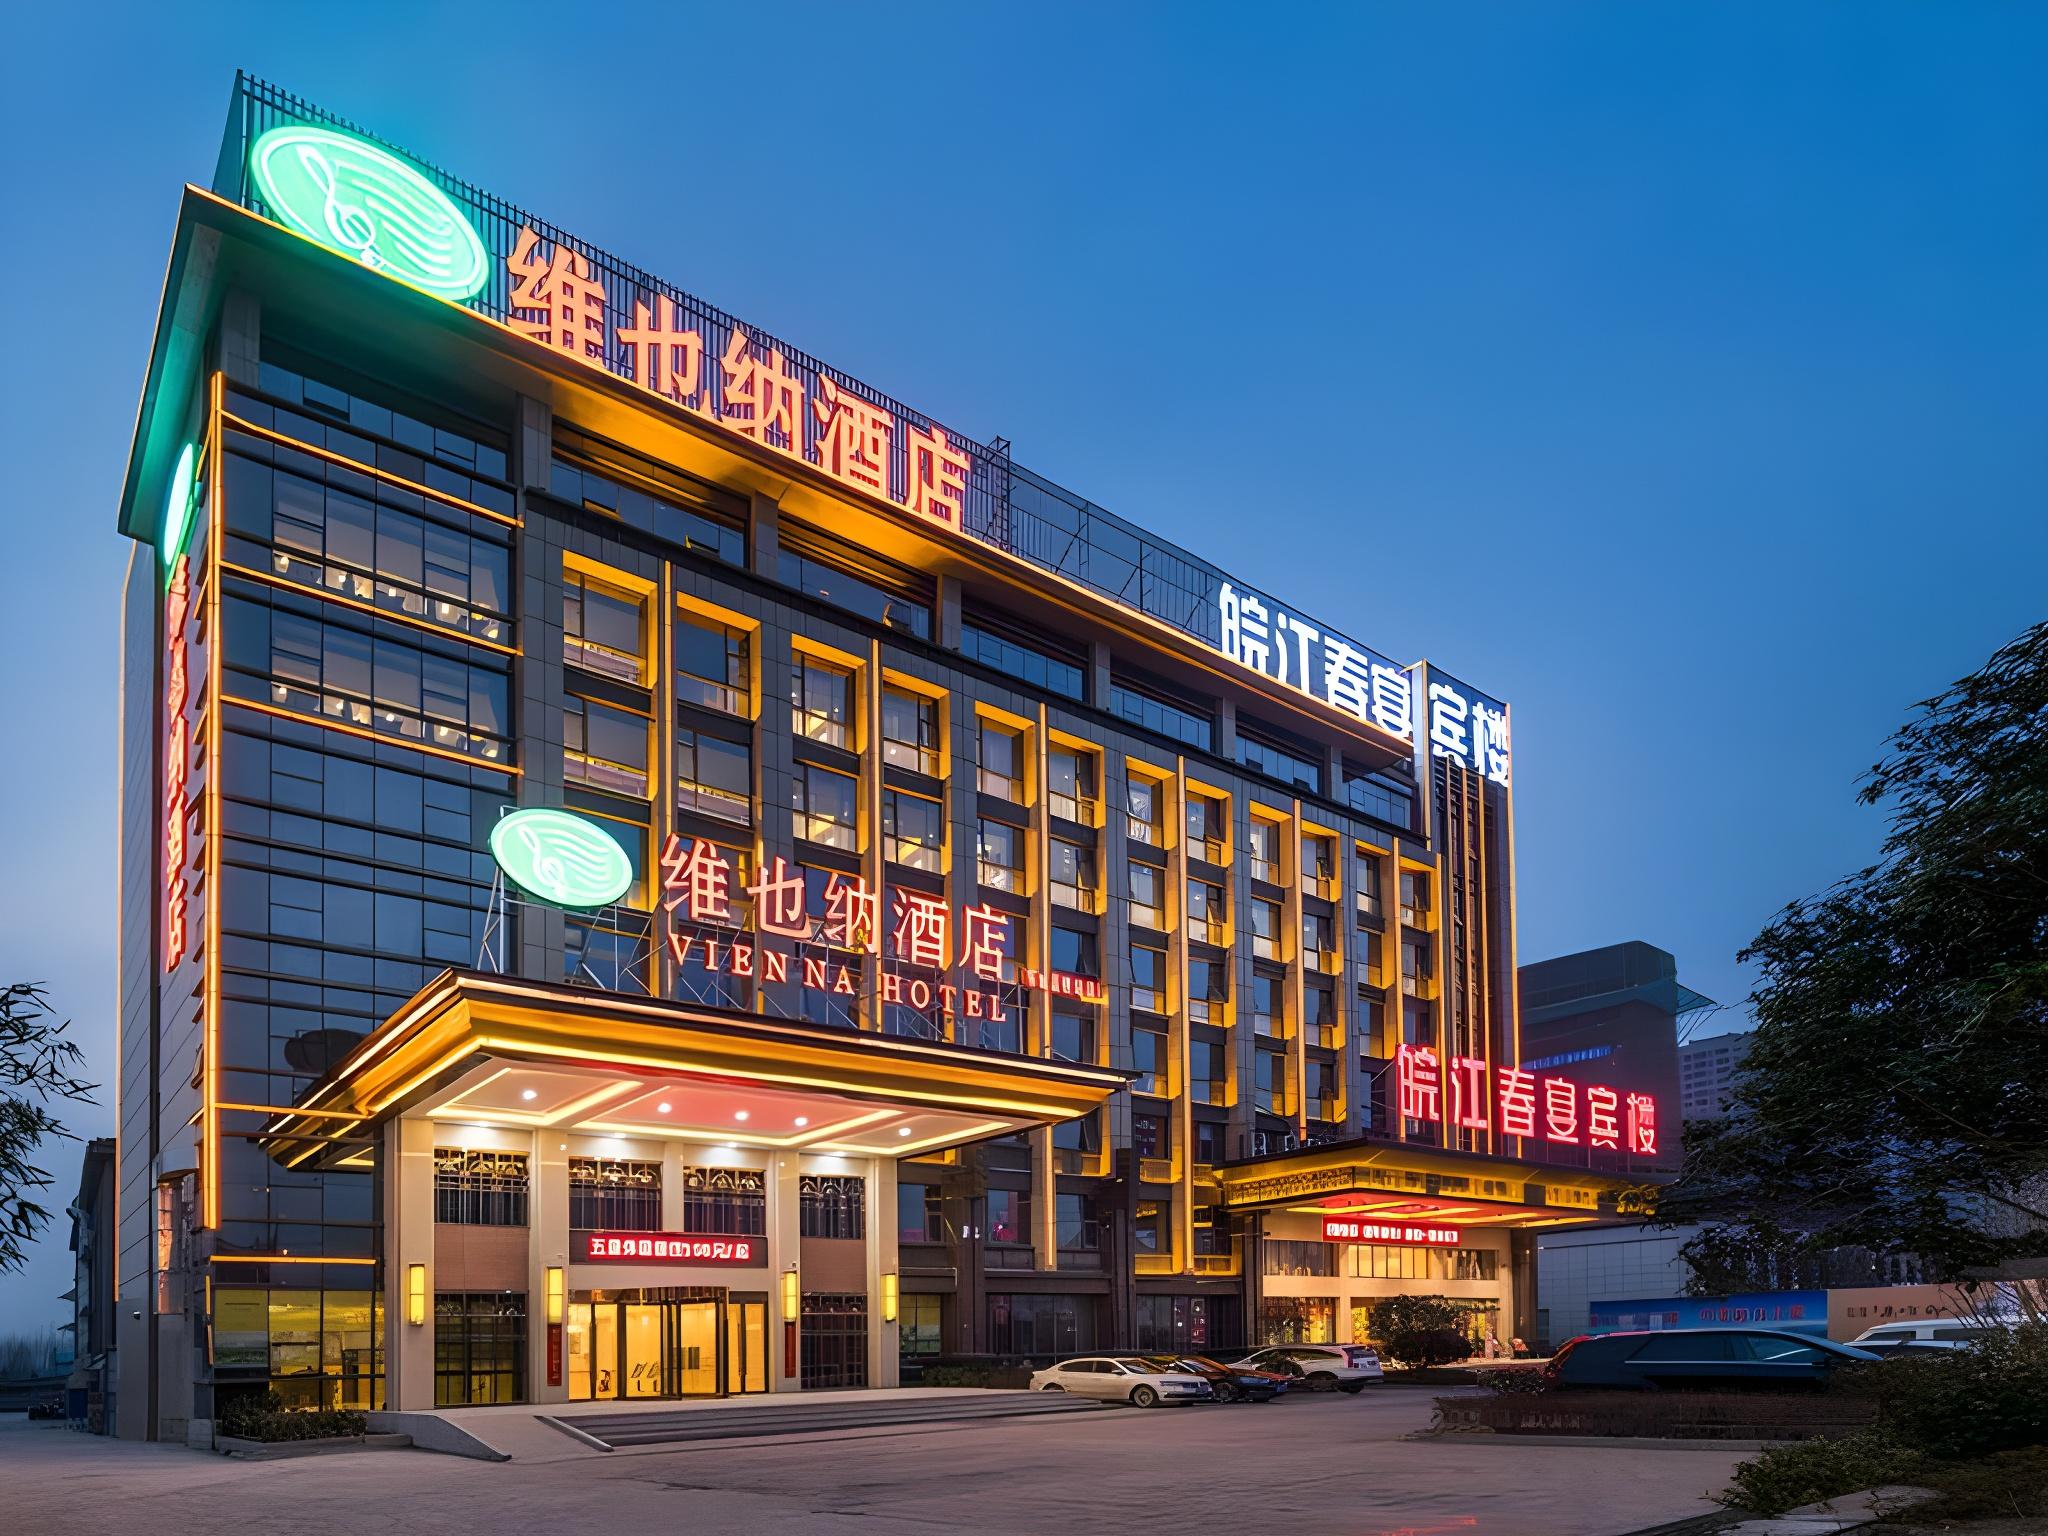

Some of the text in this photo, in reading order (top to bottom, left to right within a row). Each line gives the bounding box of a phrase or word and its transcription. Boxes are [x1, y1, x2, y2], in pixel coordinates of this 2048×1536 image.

[506, 224, 970, 533] 维也纳酒店
[661, 831, 1010, 982] 维也纳酒店
[667, 932, 855, 996] VIENNA
[881, 972, 1007, 1022] HOTEL
